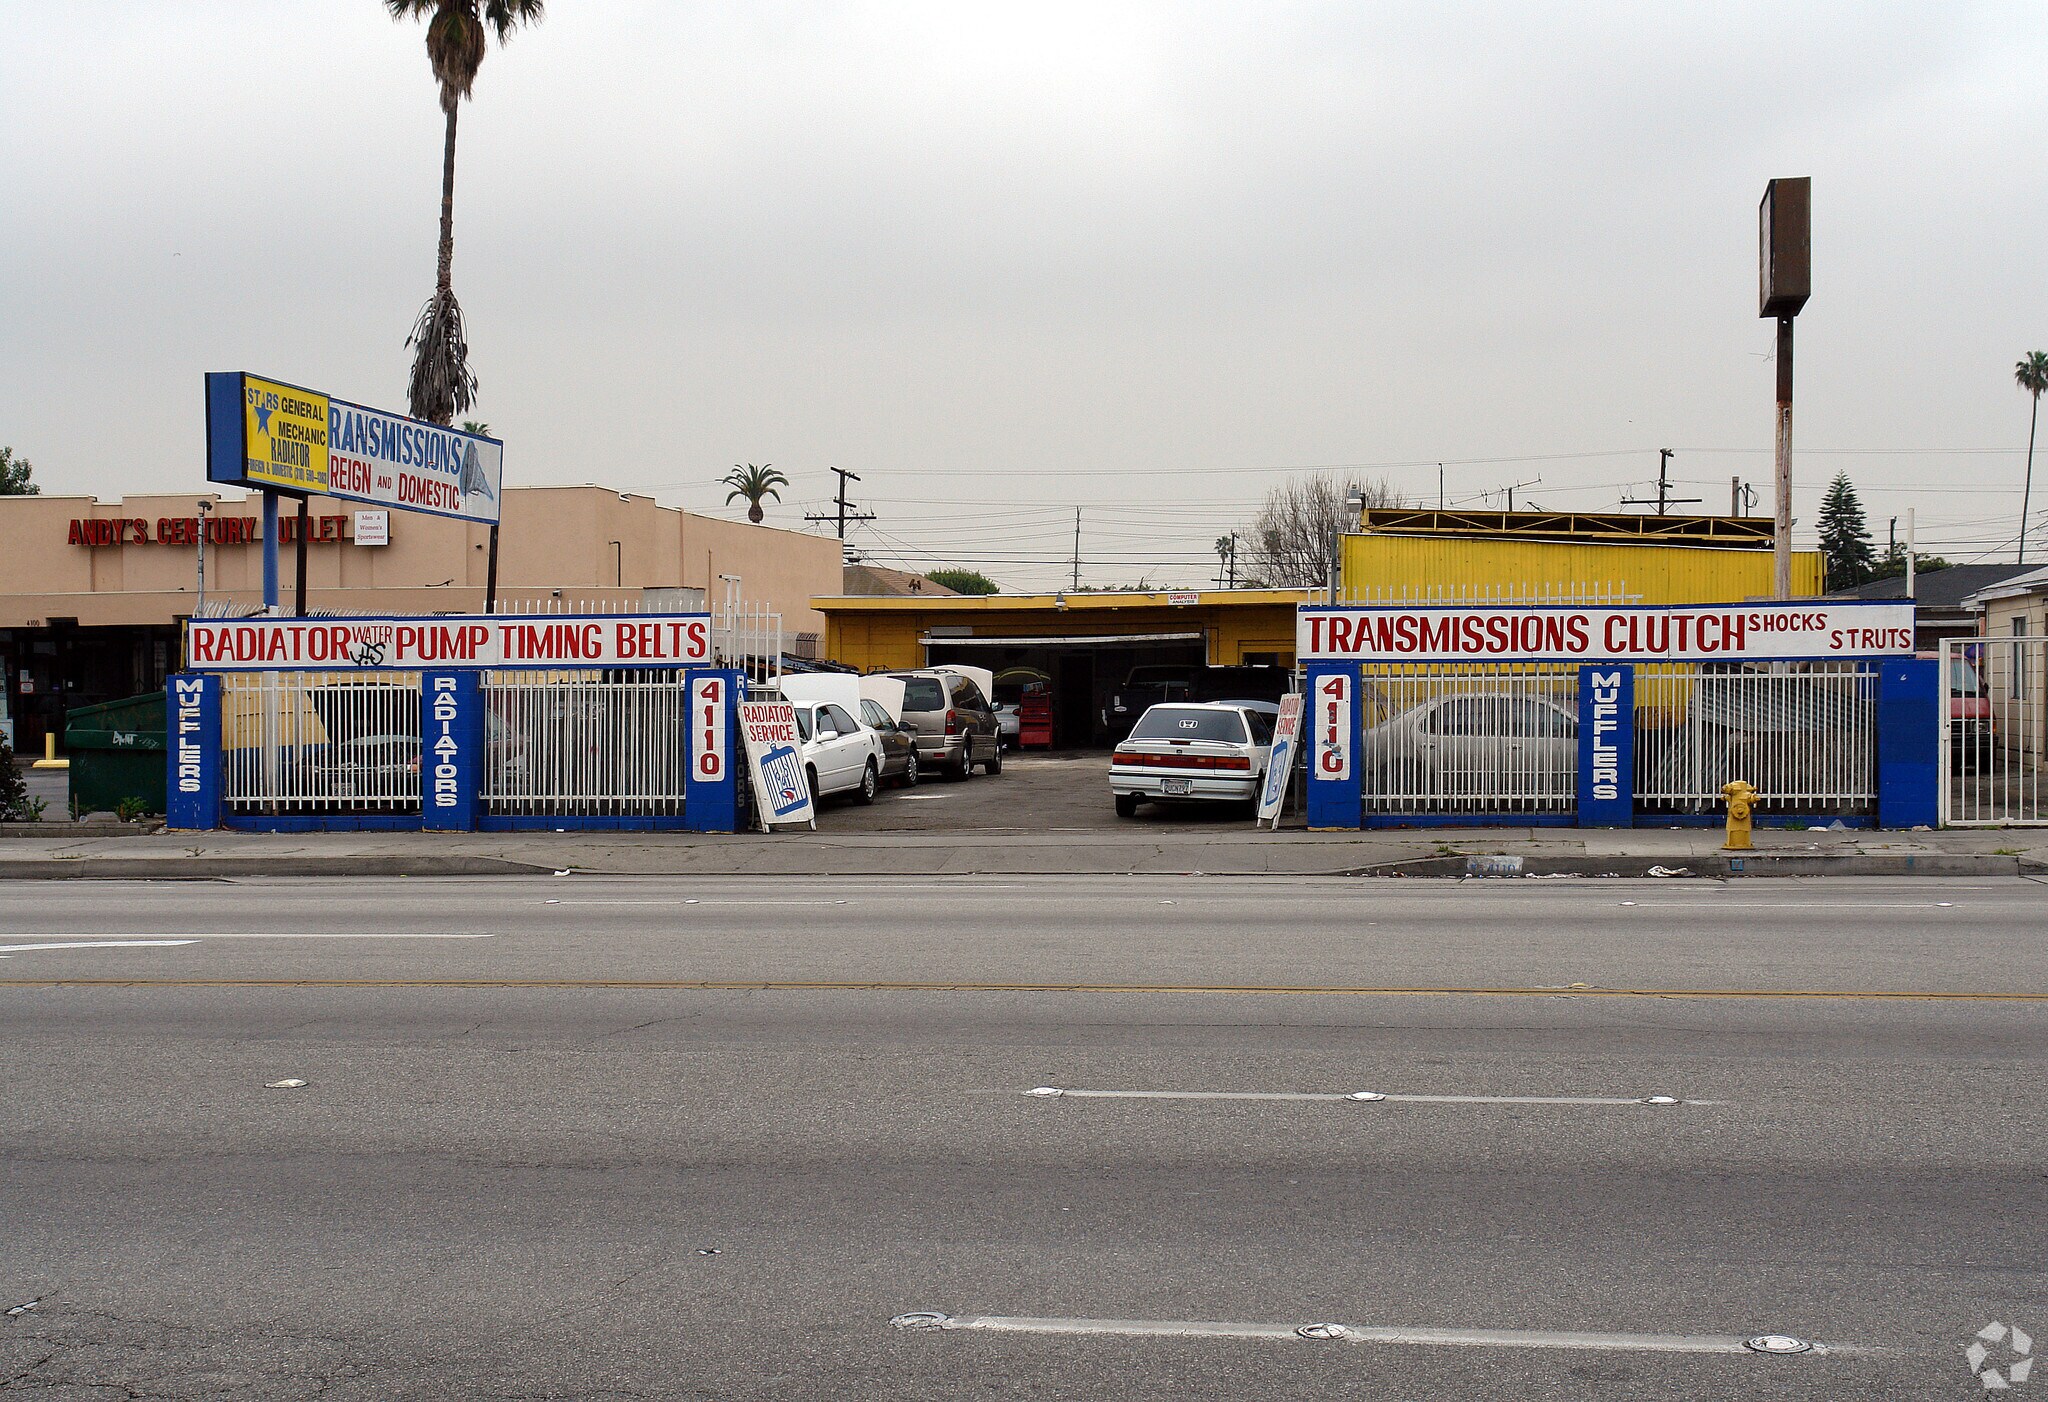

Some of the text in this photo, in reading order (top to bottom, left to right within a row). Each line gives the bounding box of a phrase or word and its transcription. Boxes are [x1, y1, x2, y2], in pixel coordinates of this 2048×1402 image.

[281, 397, 324, 422] GENERAL
[278, 421, 326, 446] MECHANIC
[270, 437, 310, 468] RADIATOR
[330, 454, 460, 511] REIGN AND DOMESTIC
[67, 519, 148, 546] ANDY'S
[157, 517, 257, 546] CENTURY
[194, 627, 351, 662] RADIATOR
[351, 625, 393, 645] WATER
[396, 625, 489, 660] PUMP
[499, 624, 602, 659] TIMING
[616, 622, 706, 659] BELTS
[1305, 613, 1828, 653] TRANSMISSIONS CLUTCH SHOCKS
[1829, 628, 1912, 650] STRUTS
[700, 681, 720, 775] 4110
[743, 704, 795, 723] RADIATOR
[1276, 717, 1297, 736] SERVICE
[1322, 677, 1344, 773] 4110
[175, 678, 204, 793] MUFFLERS
[433, 677, 459, 808] RADIATORS
[749, 724, 795, 742] SERVICE
[1591, 671, 1621, 801] MUFFLERS
